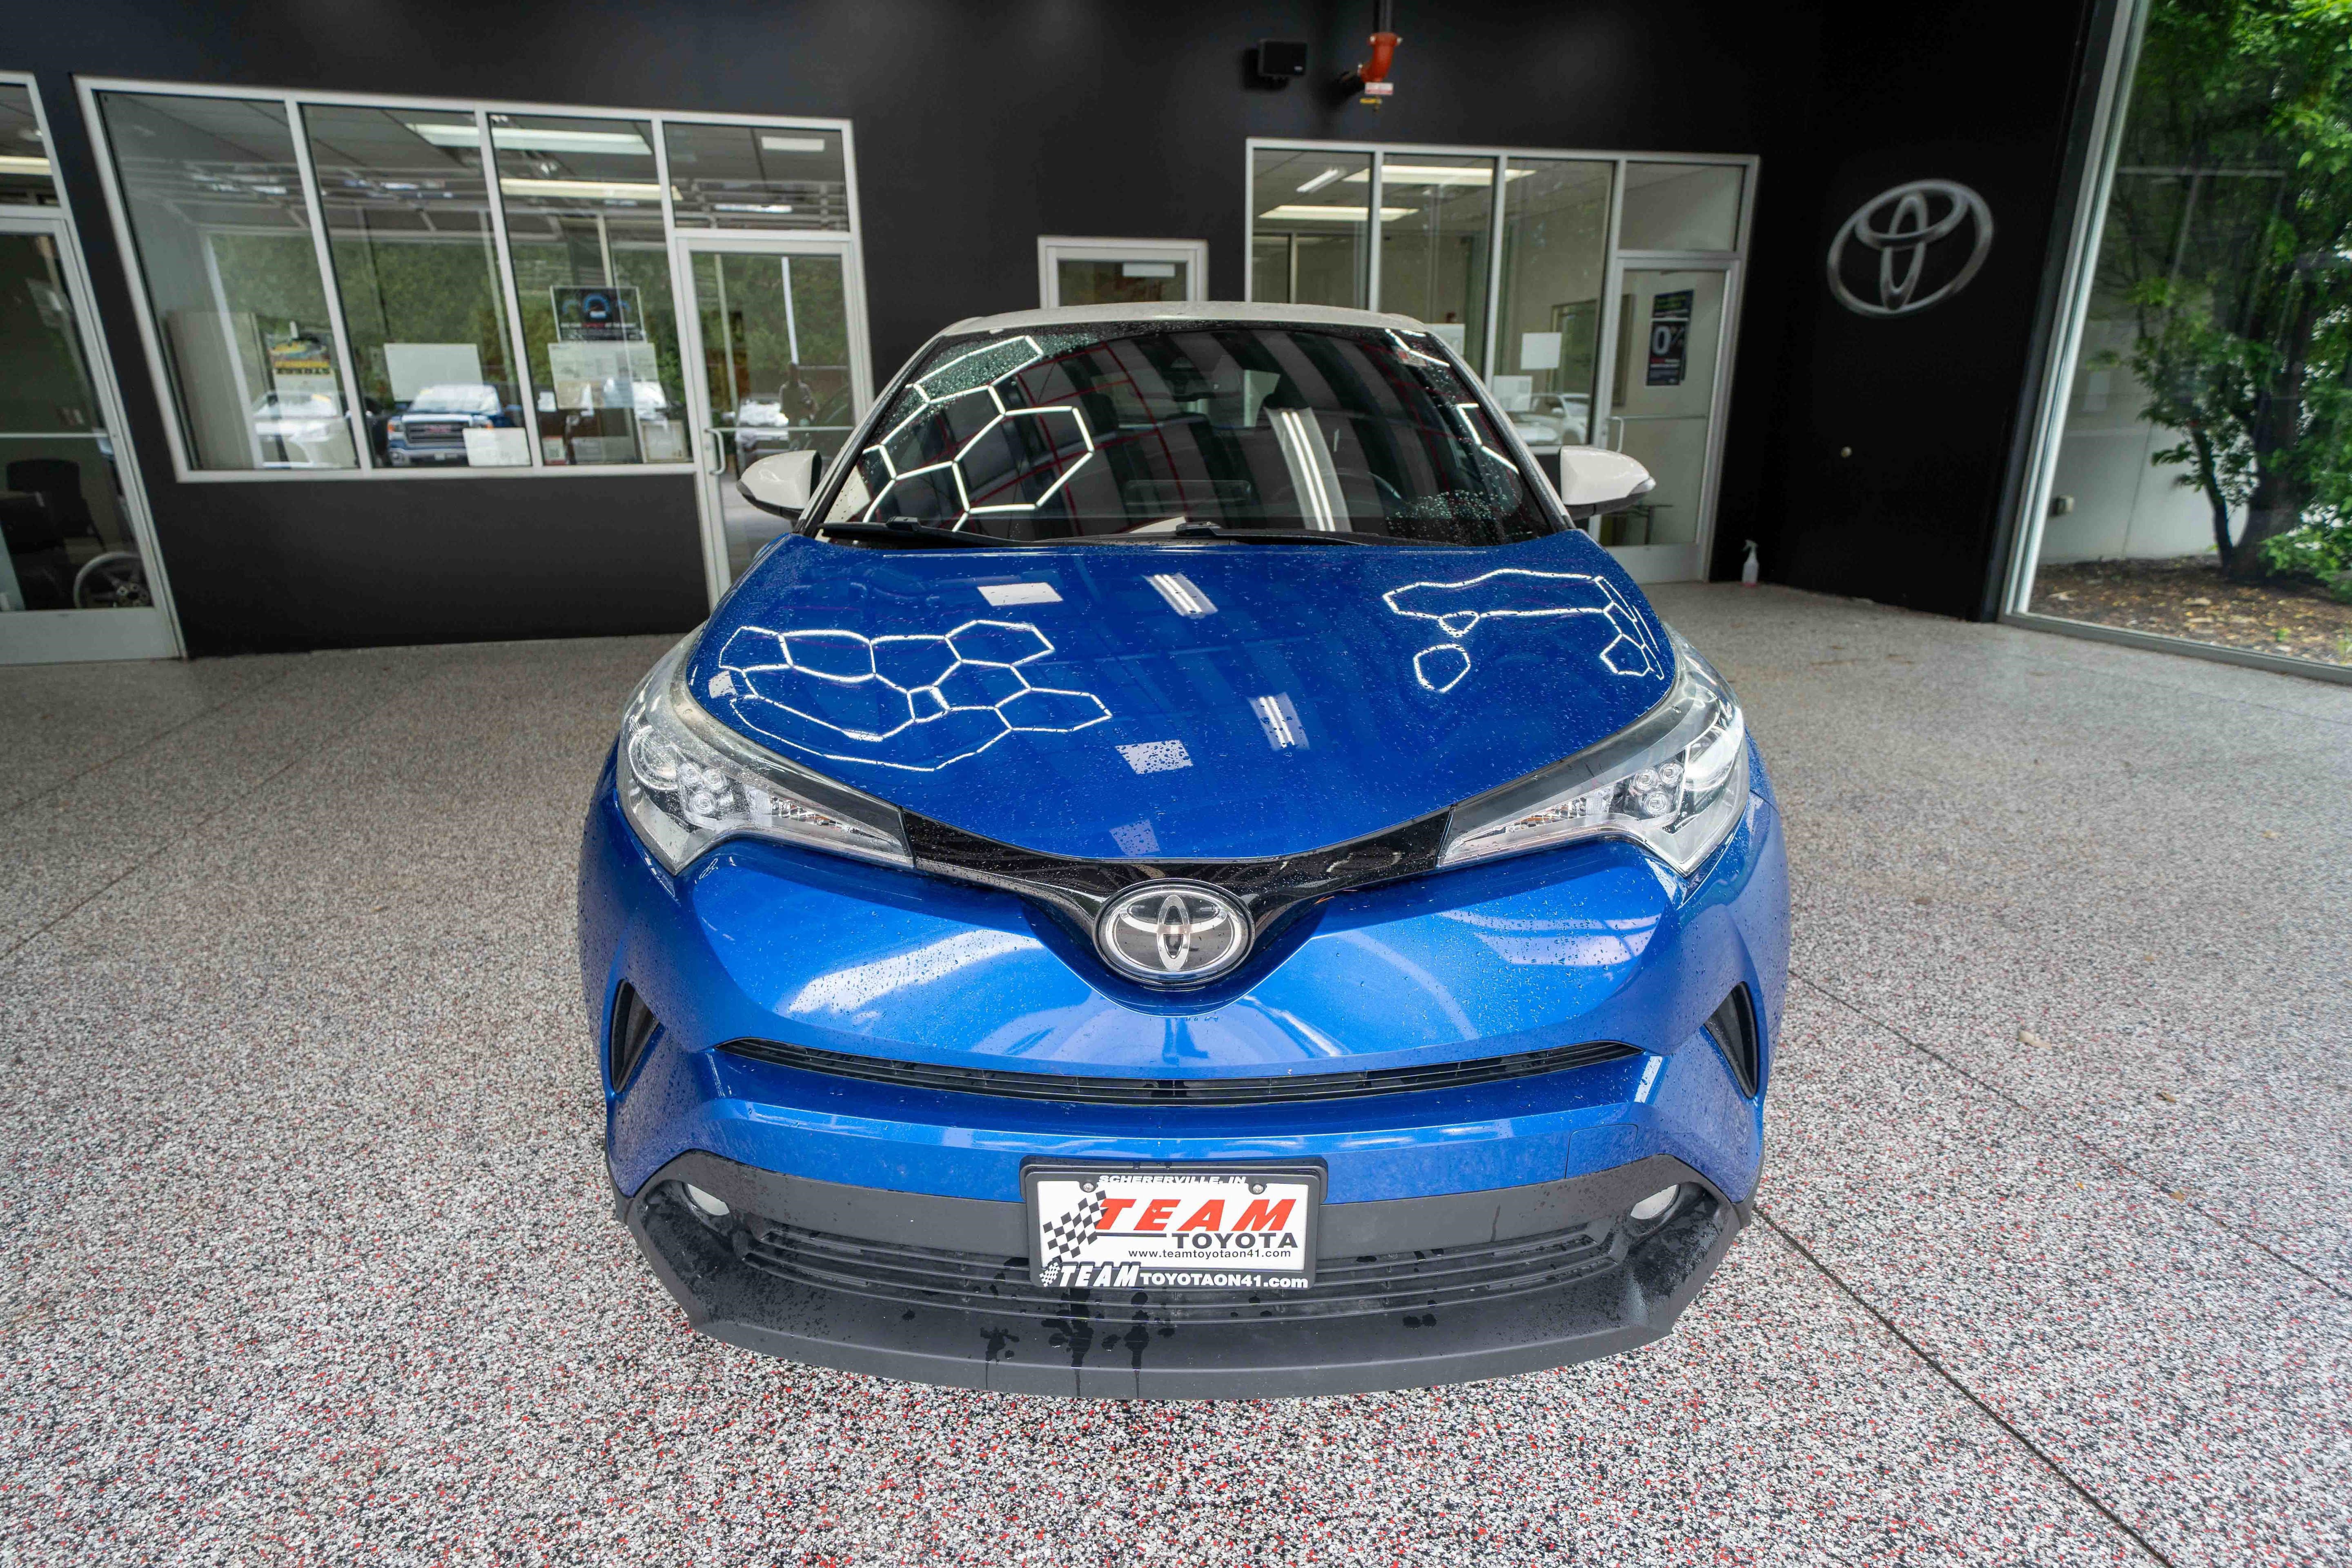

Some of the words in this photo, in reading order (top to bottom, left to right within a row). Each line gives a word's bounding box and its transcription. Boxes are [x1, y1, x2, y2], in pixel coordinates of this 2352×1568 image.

[1096, 1199, 1296, 1231] TEAM
[1172, 1233, 1298, 1249] TOYOTA
[1128, 1250, 1291, 1259] www.teamtoyotaon41.com
[1060, 1265, 1140, 1287] TEAM
[1140, 1272, 1308, 1288] TOYOTAON41.com
